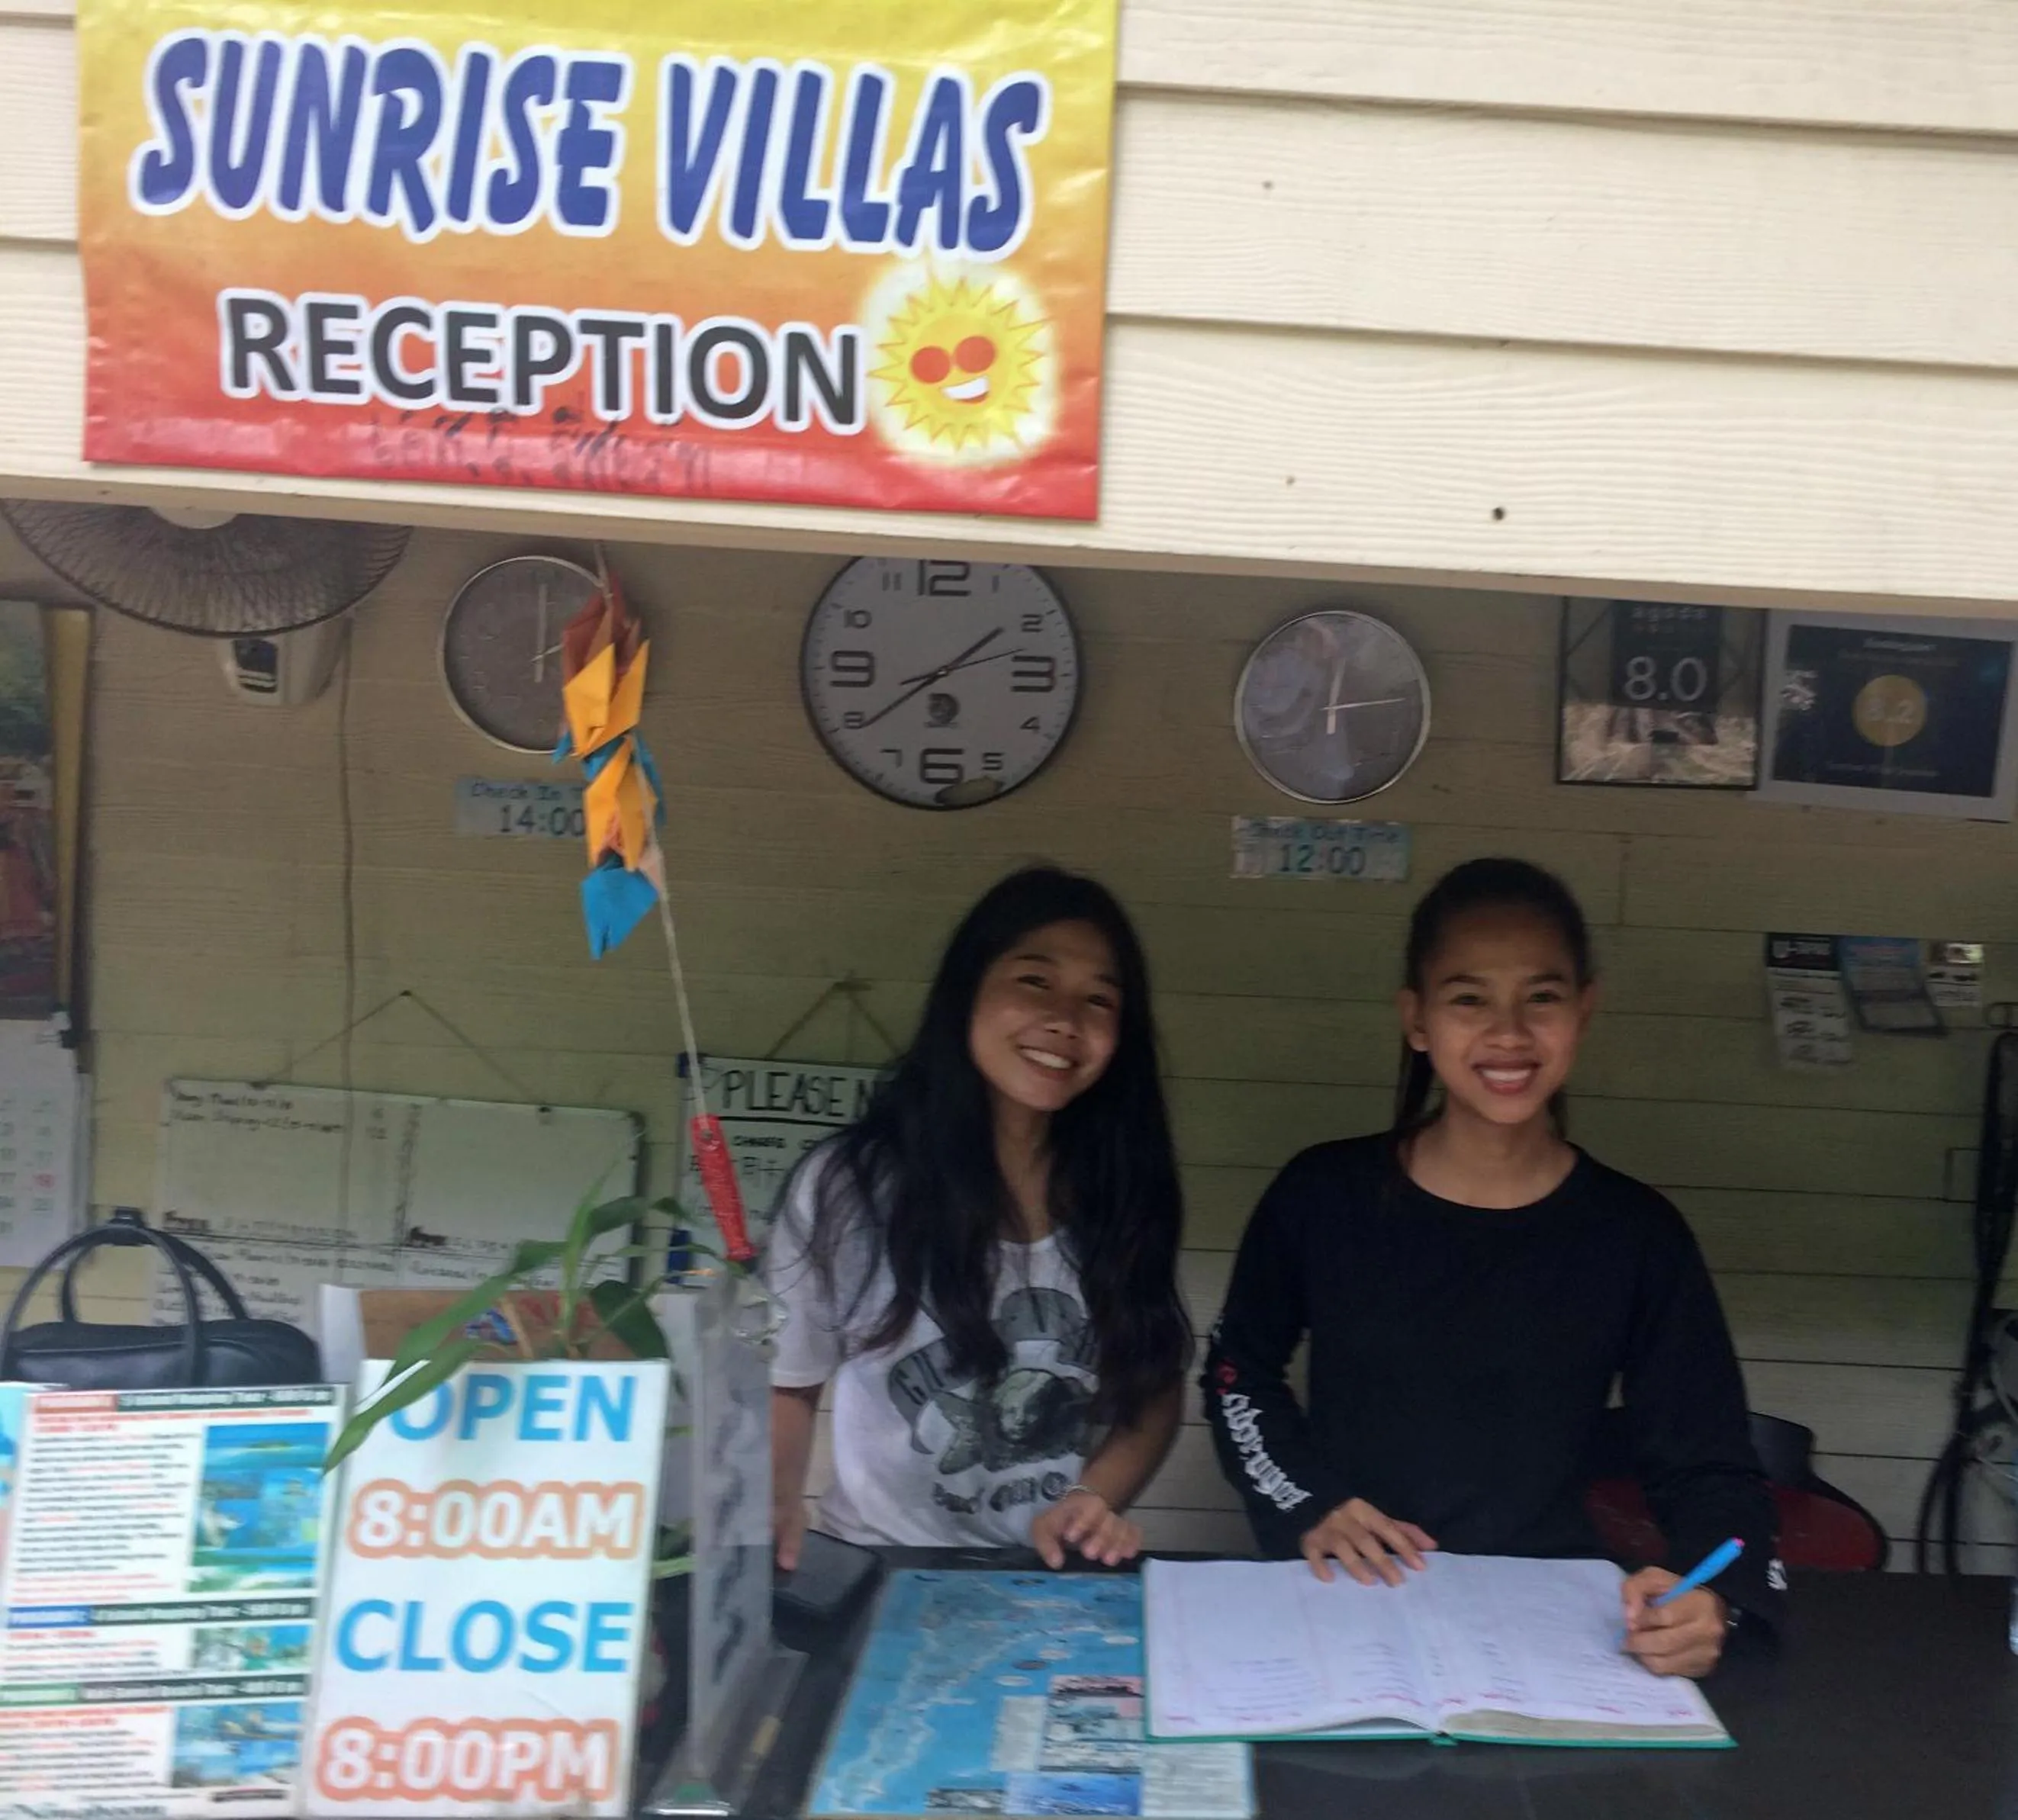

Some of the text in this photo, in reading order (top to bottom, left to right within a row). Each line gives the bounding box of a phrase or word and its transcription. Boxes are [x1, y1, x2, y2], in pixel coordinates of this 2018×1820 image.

[138, 37, 1042, 253] SUNRISE VILLAS
[225, 296, 859, 427] RECEPTION
[917, 559, 971, 596] 12
[844, 609, 873, 629] 10
[1021, 613, 1043, 632] 2
[830, 650, 875, 687] 9
[1011, 654, 1057, 693] 3
[1623, 655, 1708, 703] 8.0
[843, 711, 865, 730] 8
[1020, 715, 1041, 734] 4
[880, 748, 903, 767] 7
[920, 747, 966, 784] 6
[981, 752, 1004, 771] 5
[499, 804, 586, 837] 14:00
[1279, 843, 1367, 876] 12:00
[720, 1069, 848, 1117] PLEASE
[388, 1373, 639, 1442] OPEN
[353, 1485, 641, 1554] 8:00AM
[334, 1598, 636, 1674] CLOSE
[321, 1724, 613, 1794] 8:00PM
